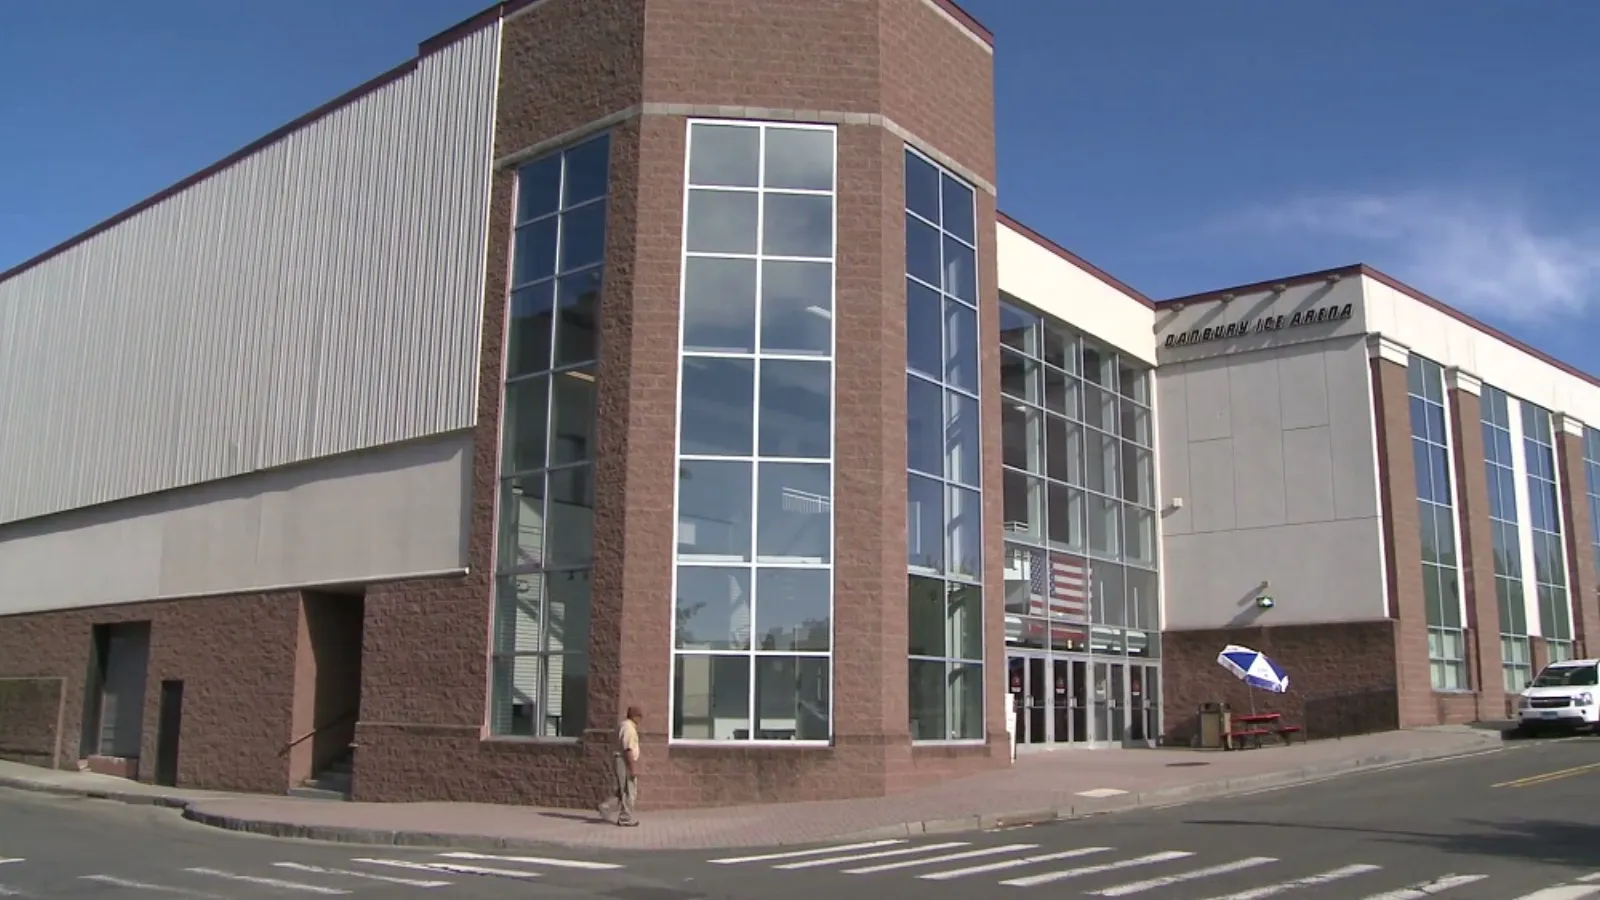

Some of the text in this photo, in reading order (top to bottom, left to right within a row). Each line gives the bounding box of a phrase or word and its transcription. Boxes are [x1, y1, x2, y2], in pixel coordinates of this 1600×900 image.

[1165, 303, 1352, 348] DANBURY ICE ARENA
